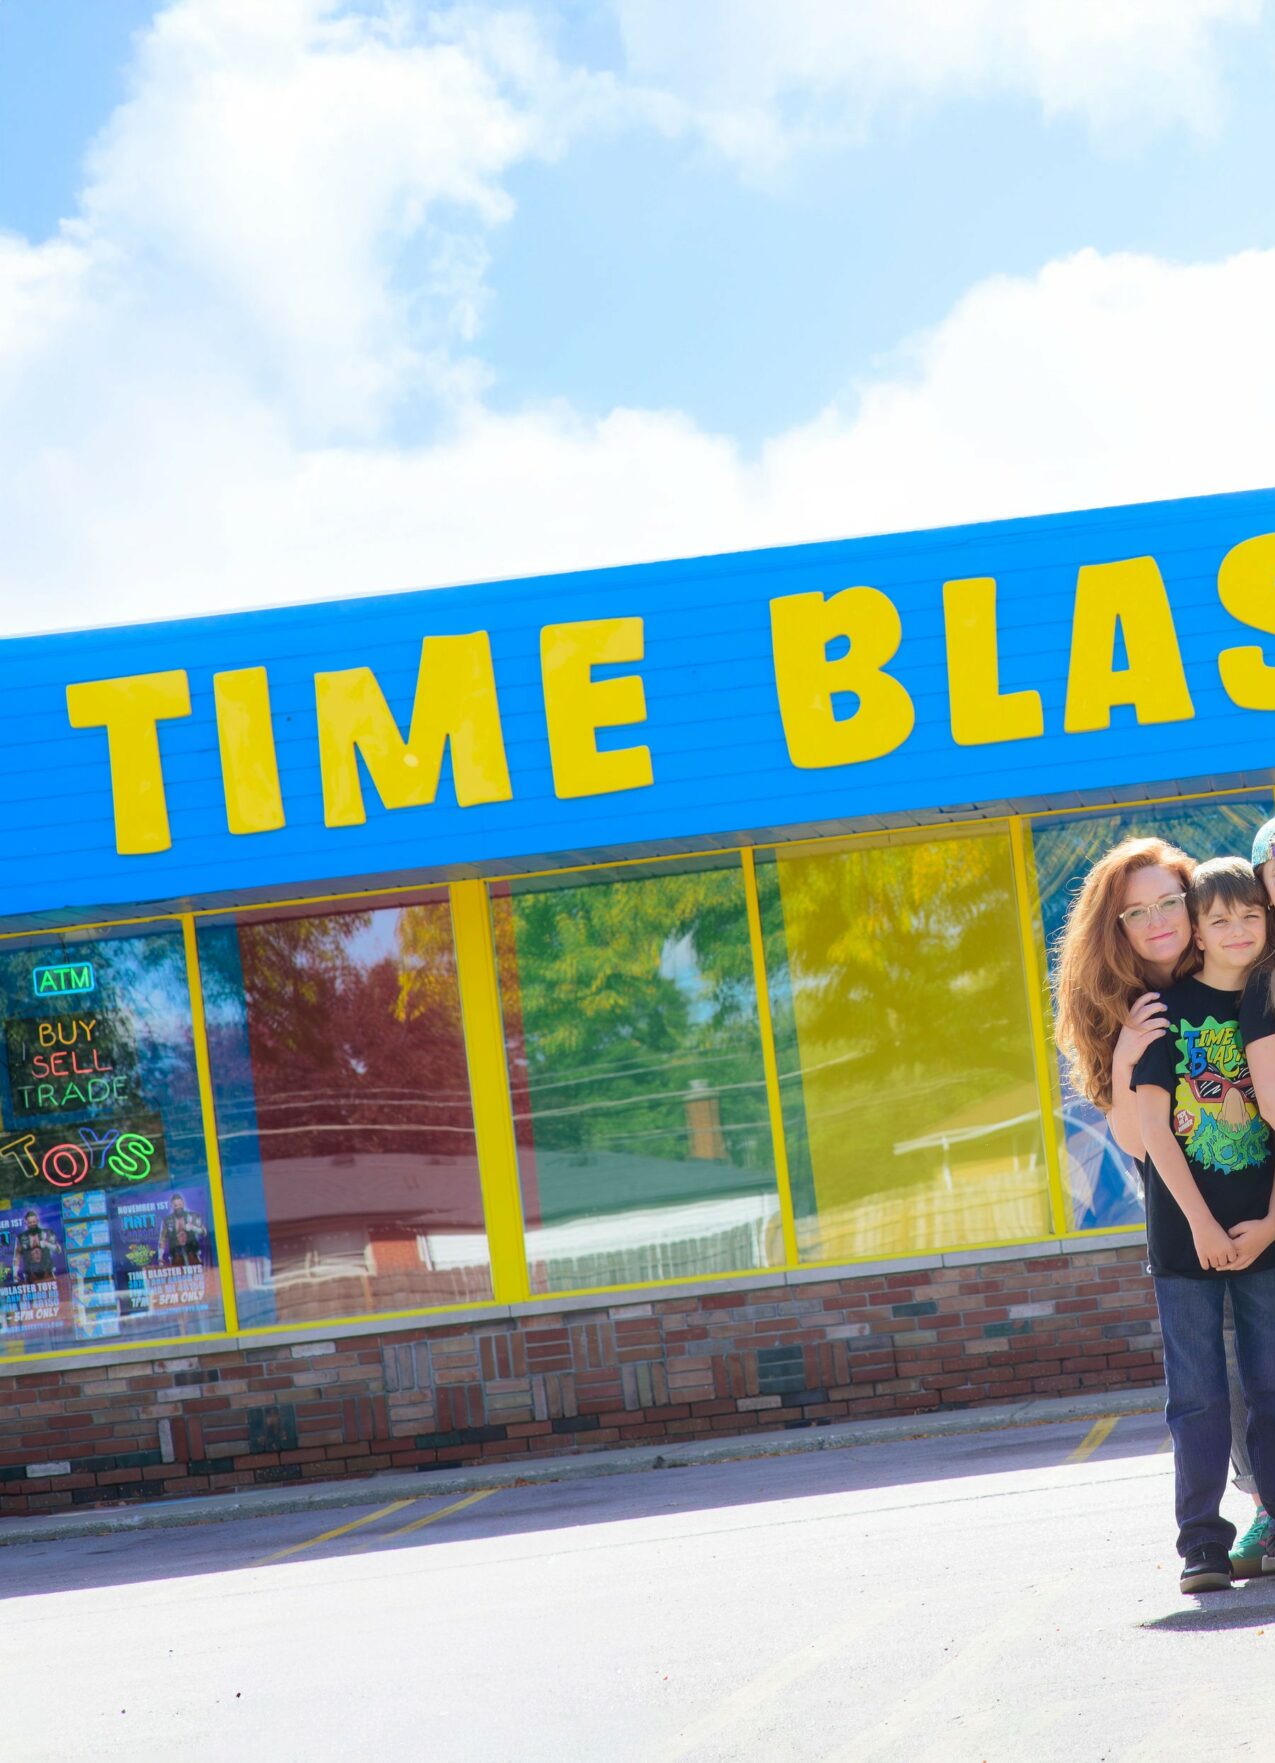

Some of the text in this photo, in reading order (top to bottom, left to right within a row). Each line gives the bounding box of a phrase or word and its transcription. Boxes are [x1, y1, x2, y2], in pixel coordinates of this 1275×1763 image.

[65, 616, 655, 856] TIME
[40, 967, 89, 992] ATM
[39, 1019, 97, 1048] BUY
[1183, 1027, 1236, 1059] TIME
[31, 1049, 113, 1079] SELL
[18, 1075, 129, 1110] TRADE
[0, 1126, 155, 1187] TOYS
[117, 1202, 155, 1215] NOVEMBER
[156, 1201, 169, 1210] 1ST
[11, 1218, 23, 1228] 1ST
[122, 1213, 156, 1231] MATT
[148, 1266, 182, 1279] BLASTER
[182, 1263, 203, 1274] TOYS
[37, 1280, 58, 1292] TOYS
[159, 1292, 179, 1305] 5PM
[180, 1290, 205, 1303] ONLY
[14, 1310, 34, 1322] 5PM
[35, 1307, 59, 1320] ONLY
